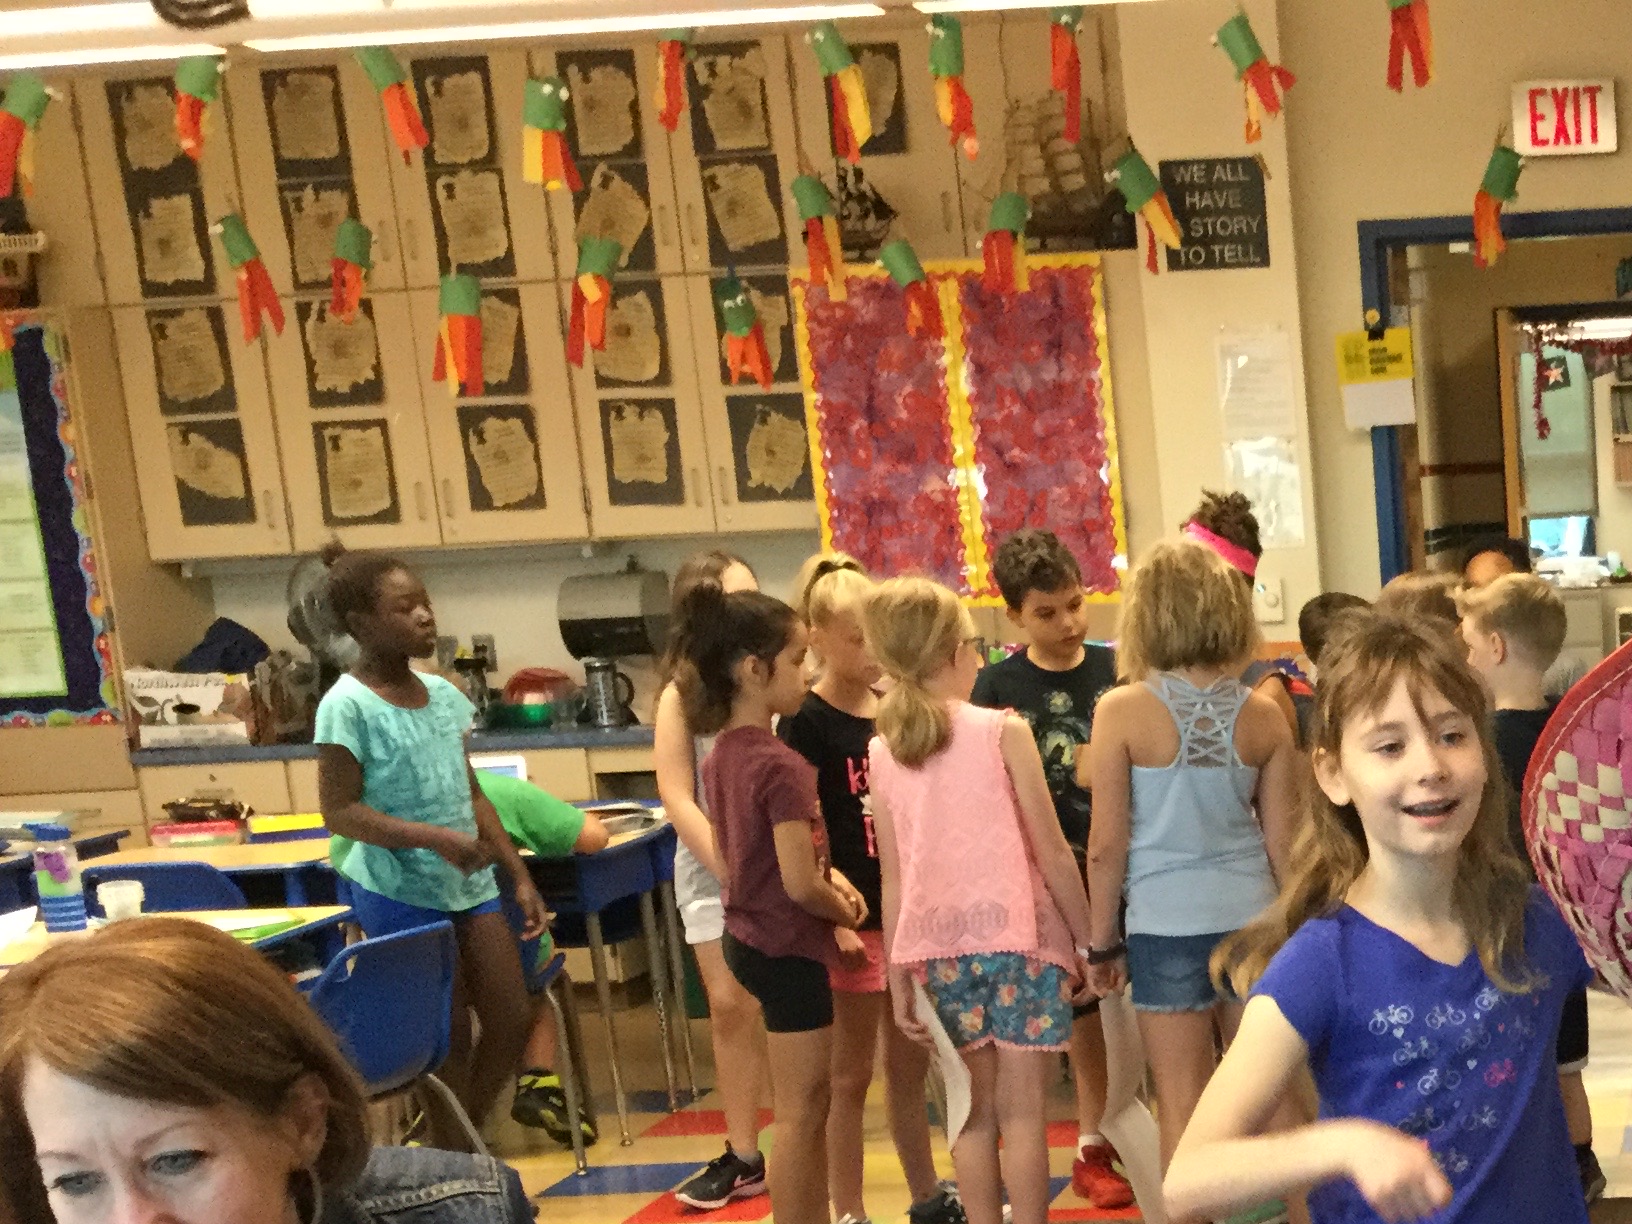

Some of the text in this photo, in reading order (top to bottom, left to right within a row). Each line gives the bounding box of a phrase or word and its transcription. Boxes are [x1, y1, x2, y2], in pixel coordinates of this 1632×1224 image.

[1528, 85, 1602, 147] EXIT
[1173, 161, 1251, 184] WE ALL
[1184, 188, 1242, 210] HAVE
[1190, 214, 1262, 238] STORY
[1179, 243, 1261, 266] TO TELL
